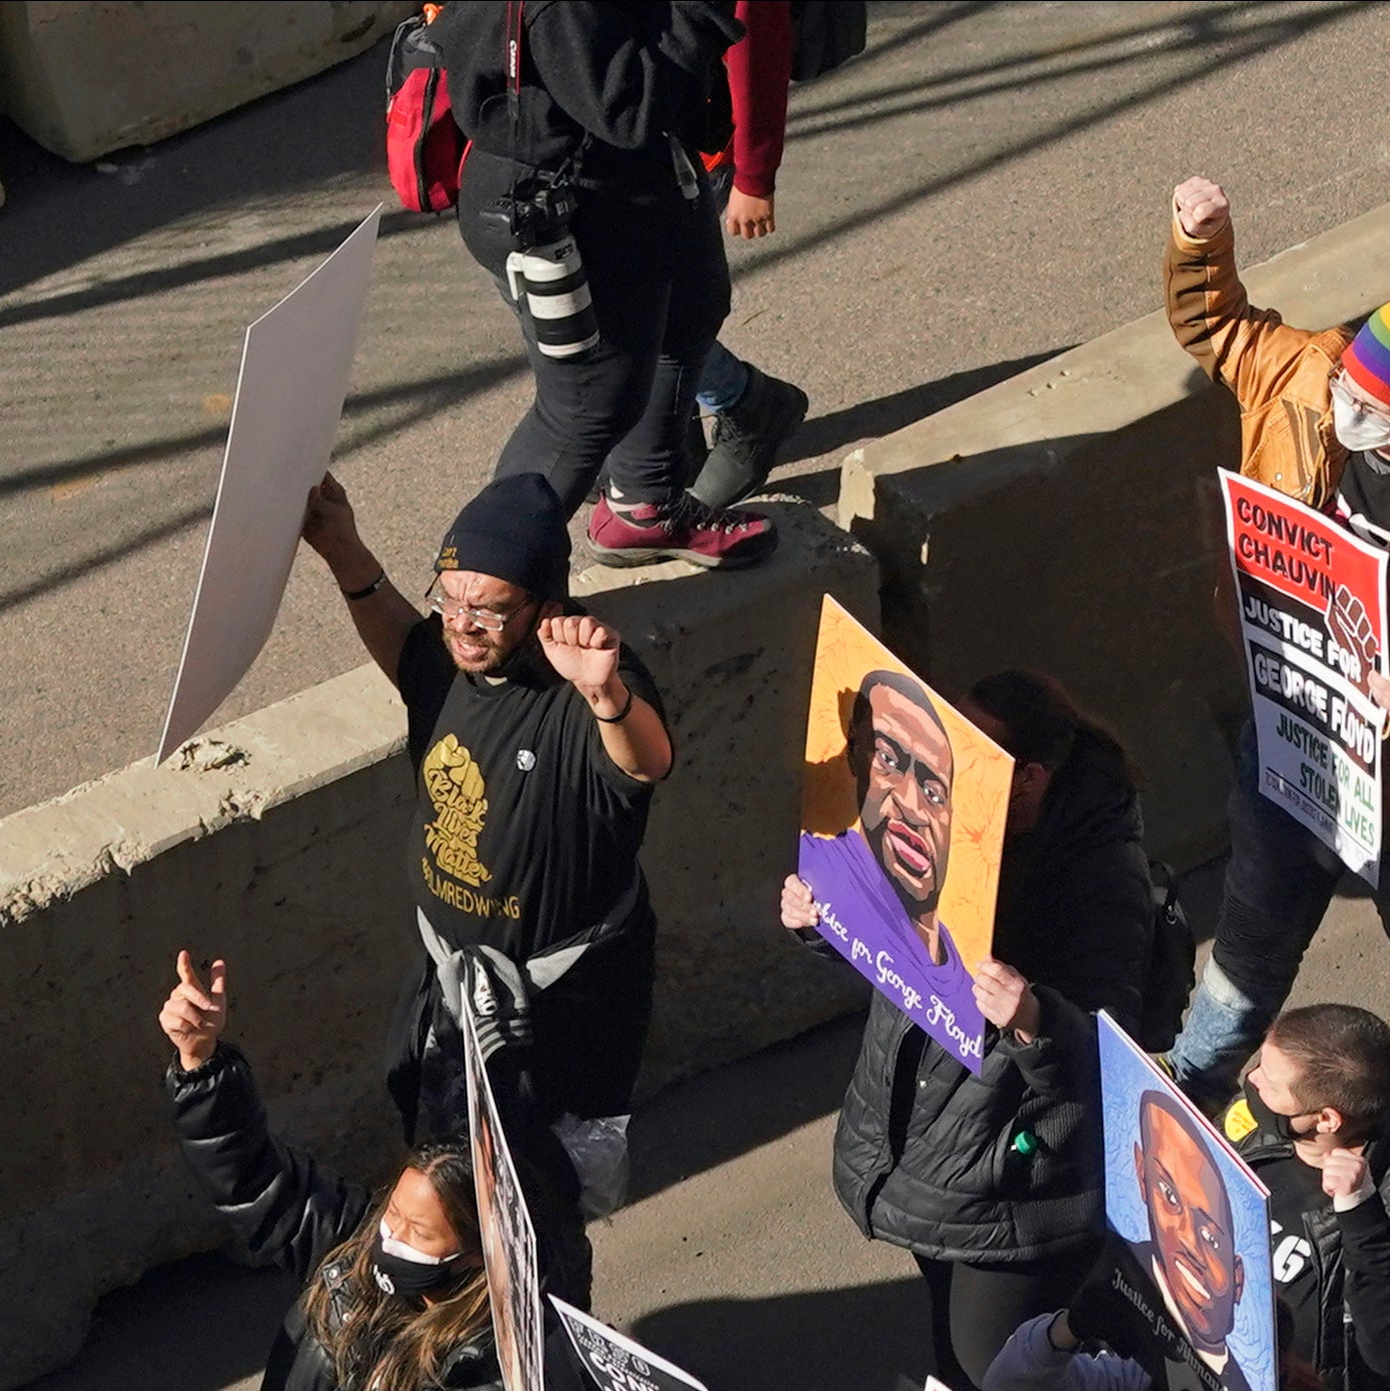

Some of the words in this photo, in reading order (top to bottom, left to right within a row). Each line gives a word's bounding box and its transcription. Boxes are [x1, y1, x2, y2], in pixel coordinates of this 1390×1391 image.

[1237, 497, 1333, 566] CONVICT
[1239, 533, 1337, 599] CHAUVIN
[1245, 596, 1324, 658] JUSTICE
[1327, 639, 1362, 682] FOR
[1253, 652, 1328, 718] GEORGE
[1331, 699, 1374, 765] FLOYD
[428, 769, 488, 825] Black
[1276, 714, 1328, 769] JUSTICE
[1332, 750, 1350, 787] FOR
[1354, 781, 1374, 811] ALL
[433, 802, 479, 848] Lives
[1300, 762, 1341, 813] STOLEN
[1344, 809, 1375, 847] LIVES
[424, 823, 493, 883] Matter
[852, 938, 873, 964] for
[876, 950, 923, 1010] George
[926, 994, 982, 1058] Floyd
[1112, 1268, 1154, 1323] Justice
[1153, 1315, 1176, 1343] for
